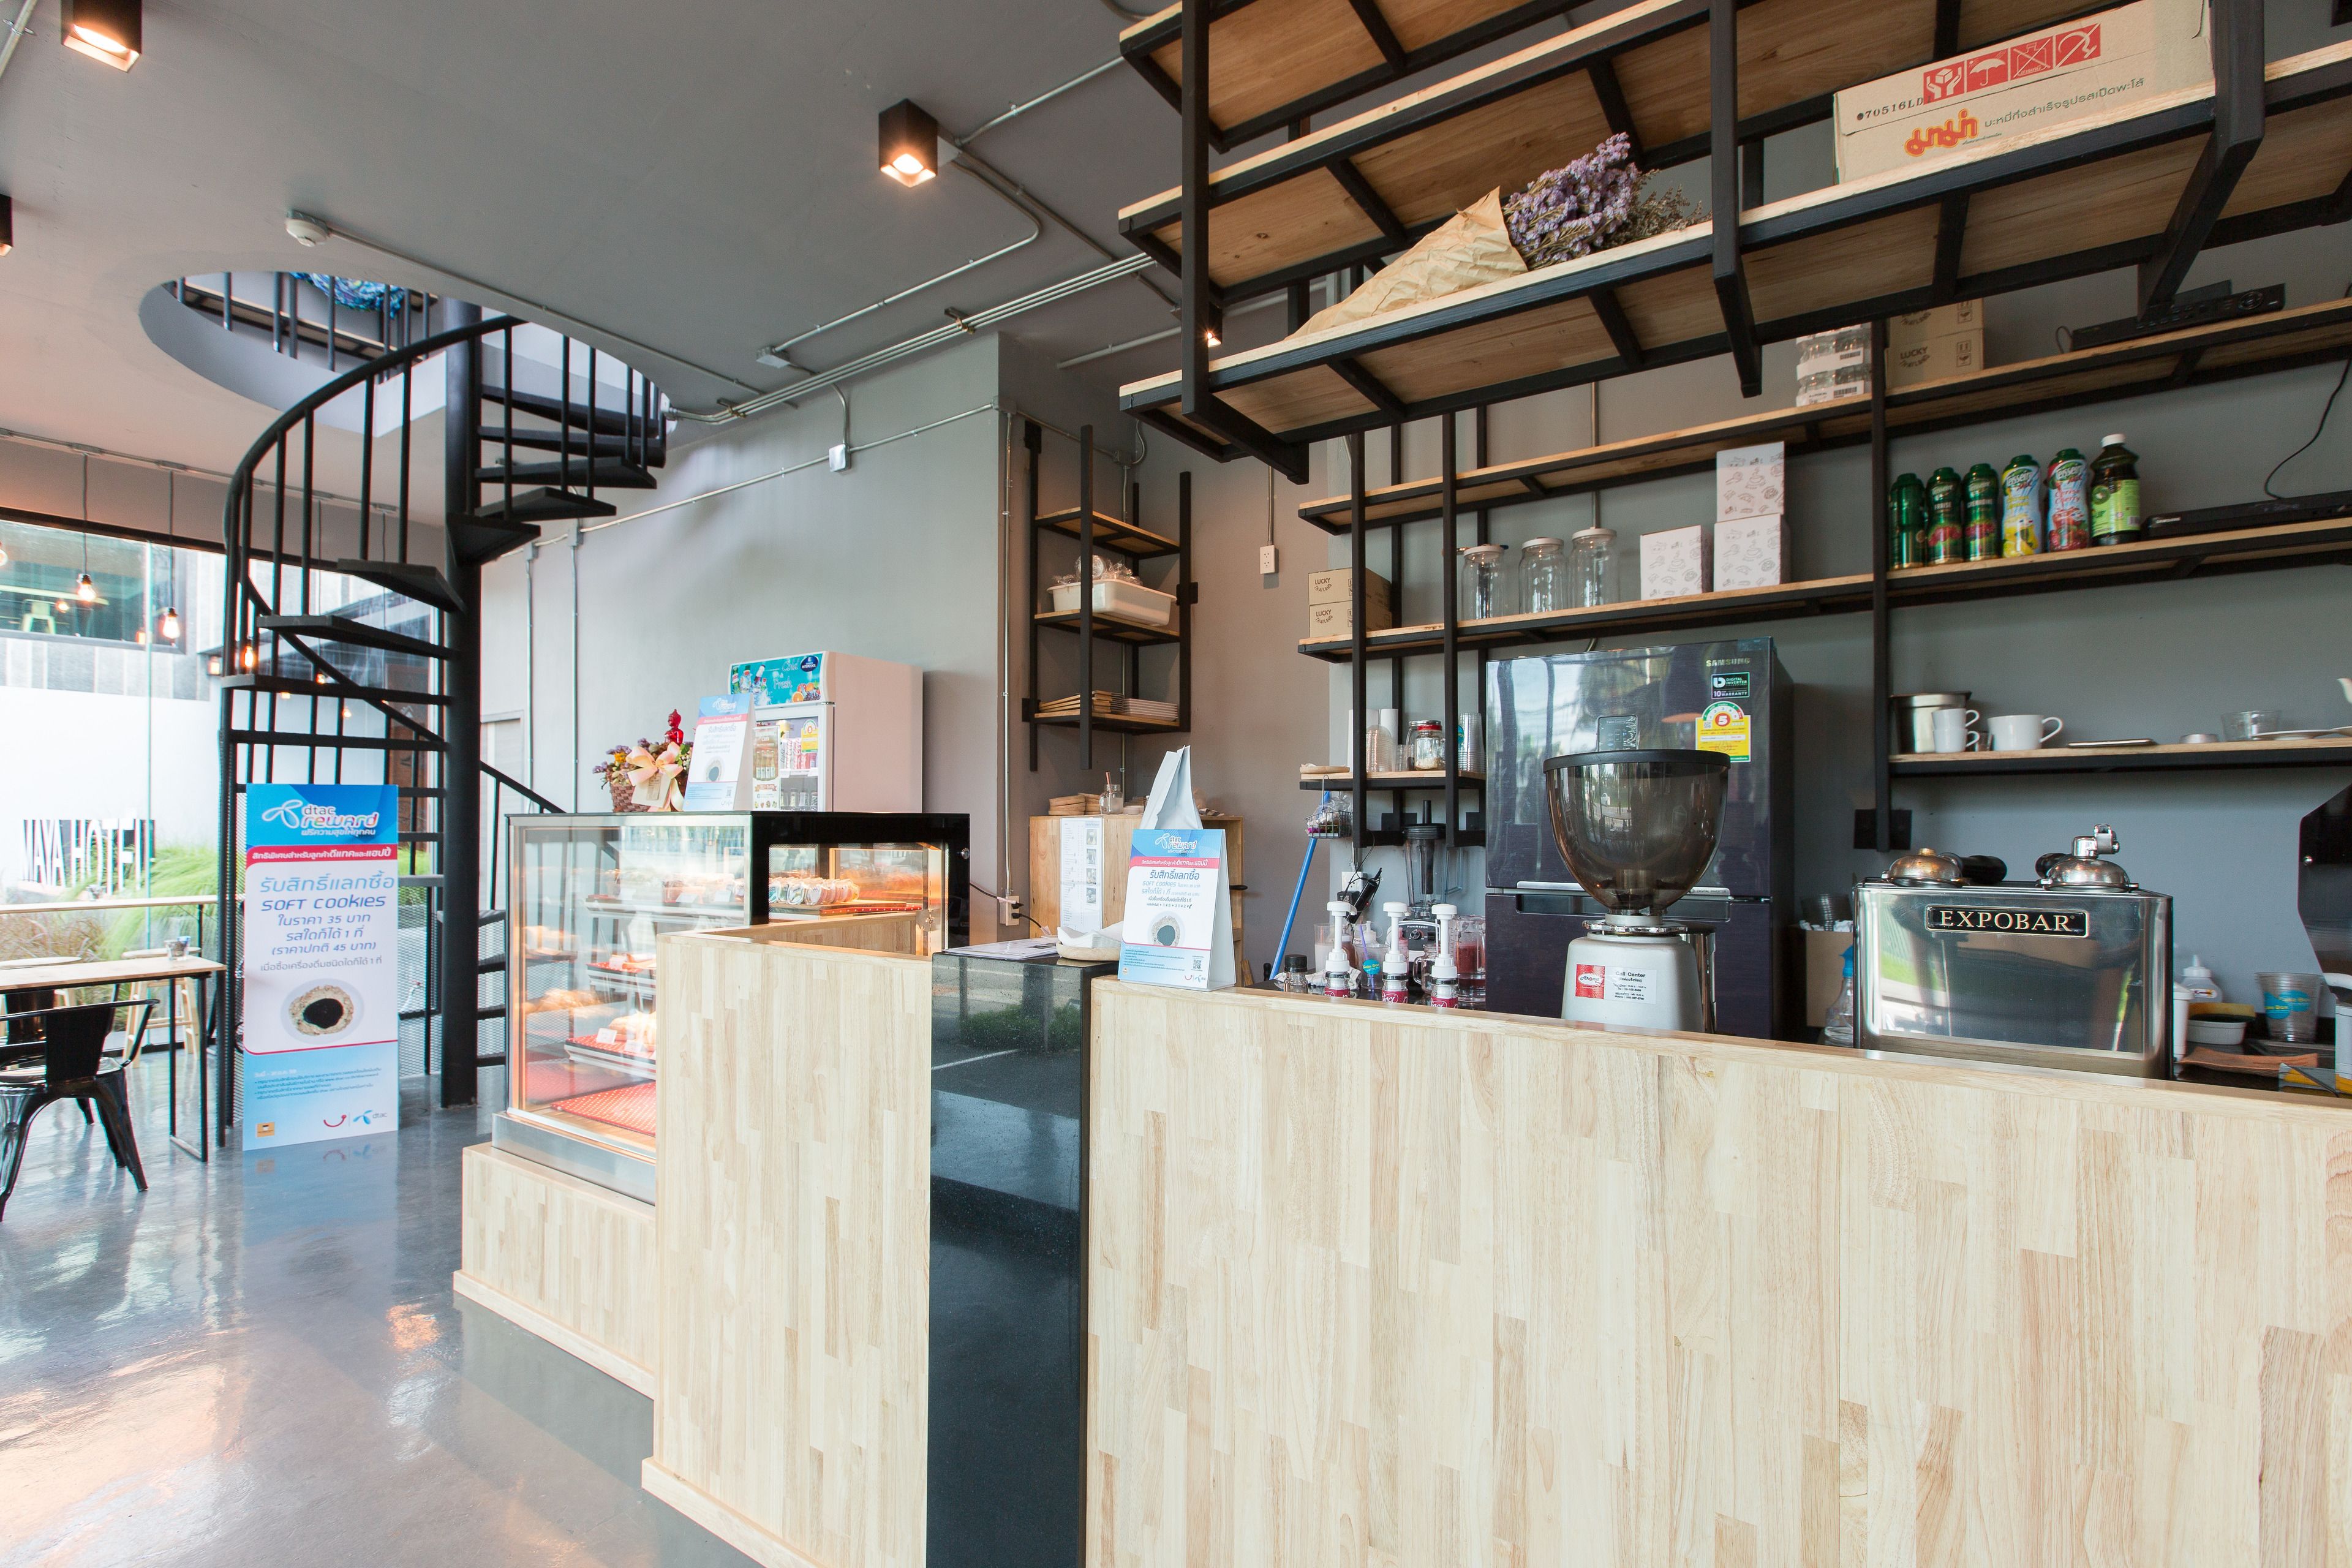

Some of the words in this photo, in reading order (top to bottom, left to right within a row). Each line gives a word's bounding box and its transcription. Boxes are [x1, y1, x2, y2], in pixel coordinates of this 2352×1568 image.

[1899, 346, 1928, 360] LUCKY
[1314, 583, 1332, 592] THAILAND
[1315, 615, 1333, 624] THAILAND
[1706, 658, 1751, 667] SAMSUNG
[1717, 715, 1728, 725] 5
[303, 805, 336, 816] dtac
[260, 870, 394, 892] รับสิทธิ์แลกซื้อ
[261, 899, 307, 911] SOFT
[277, 914, 322, 927] ในราคา
[327, 915, 342, 924] 35
[347, 913, 371, 924] บาท
[1939, 910, 2073, 932] EXPOBAR
[272, 943, 330, 956] (ราคาปกติ
[350, 941, 377, 951] บาท)
